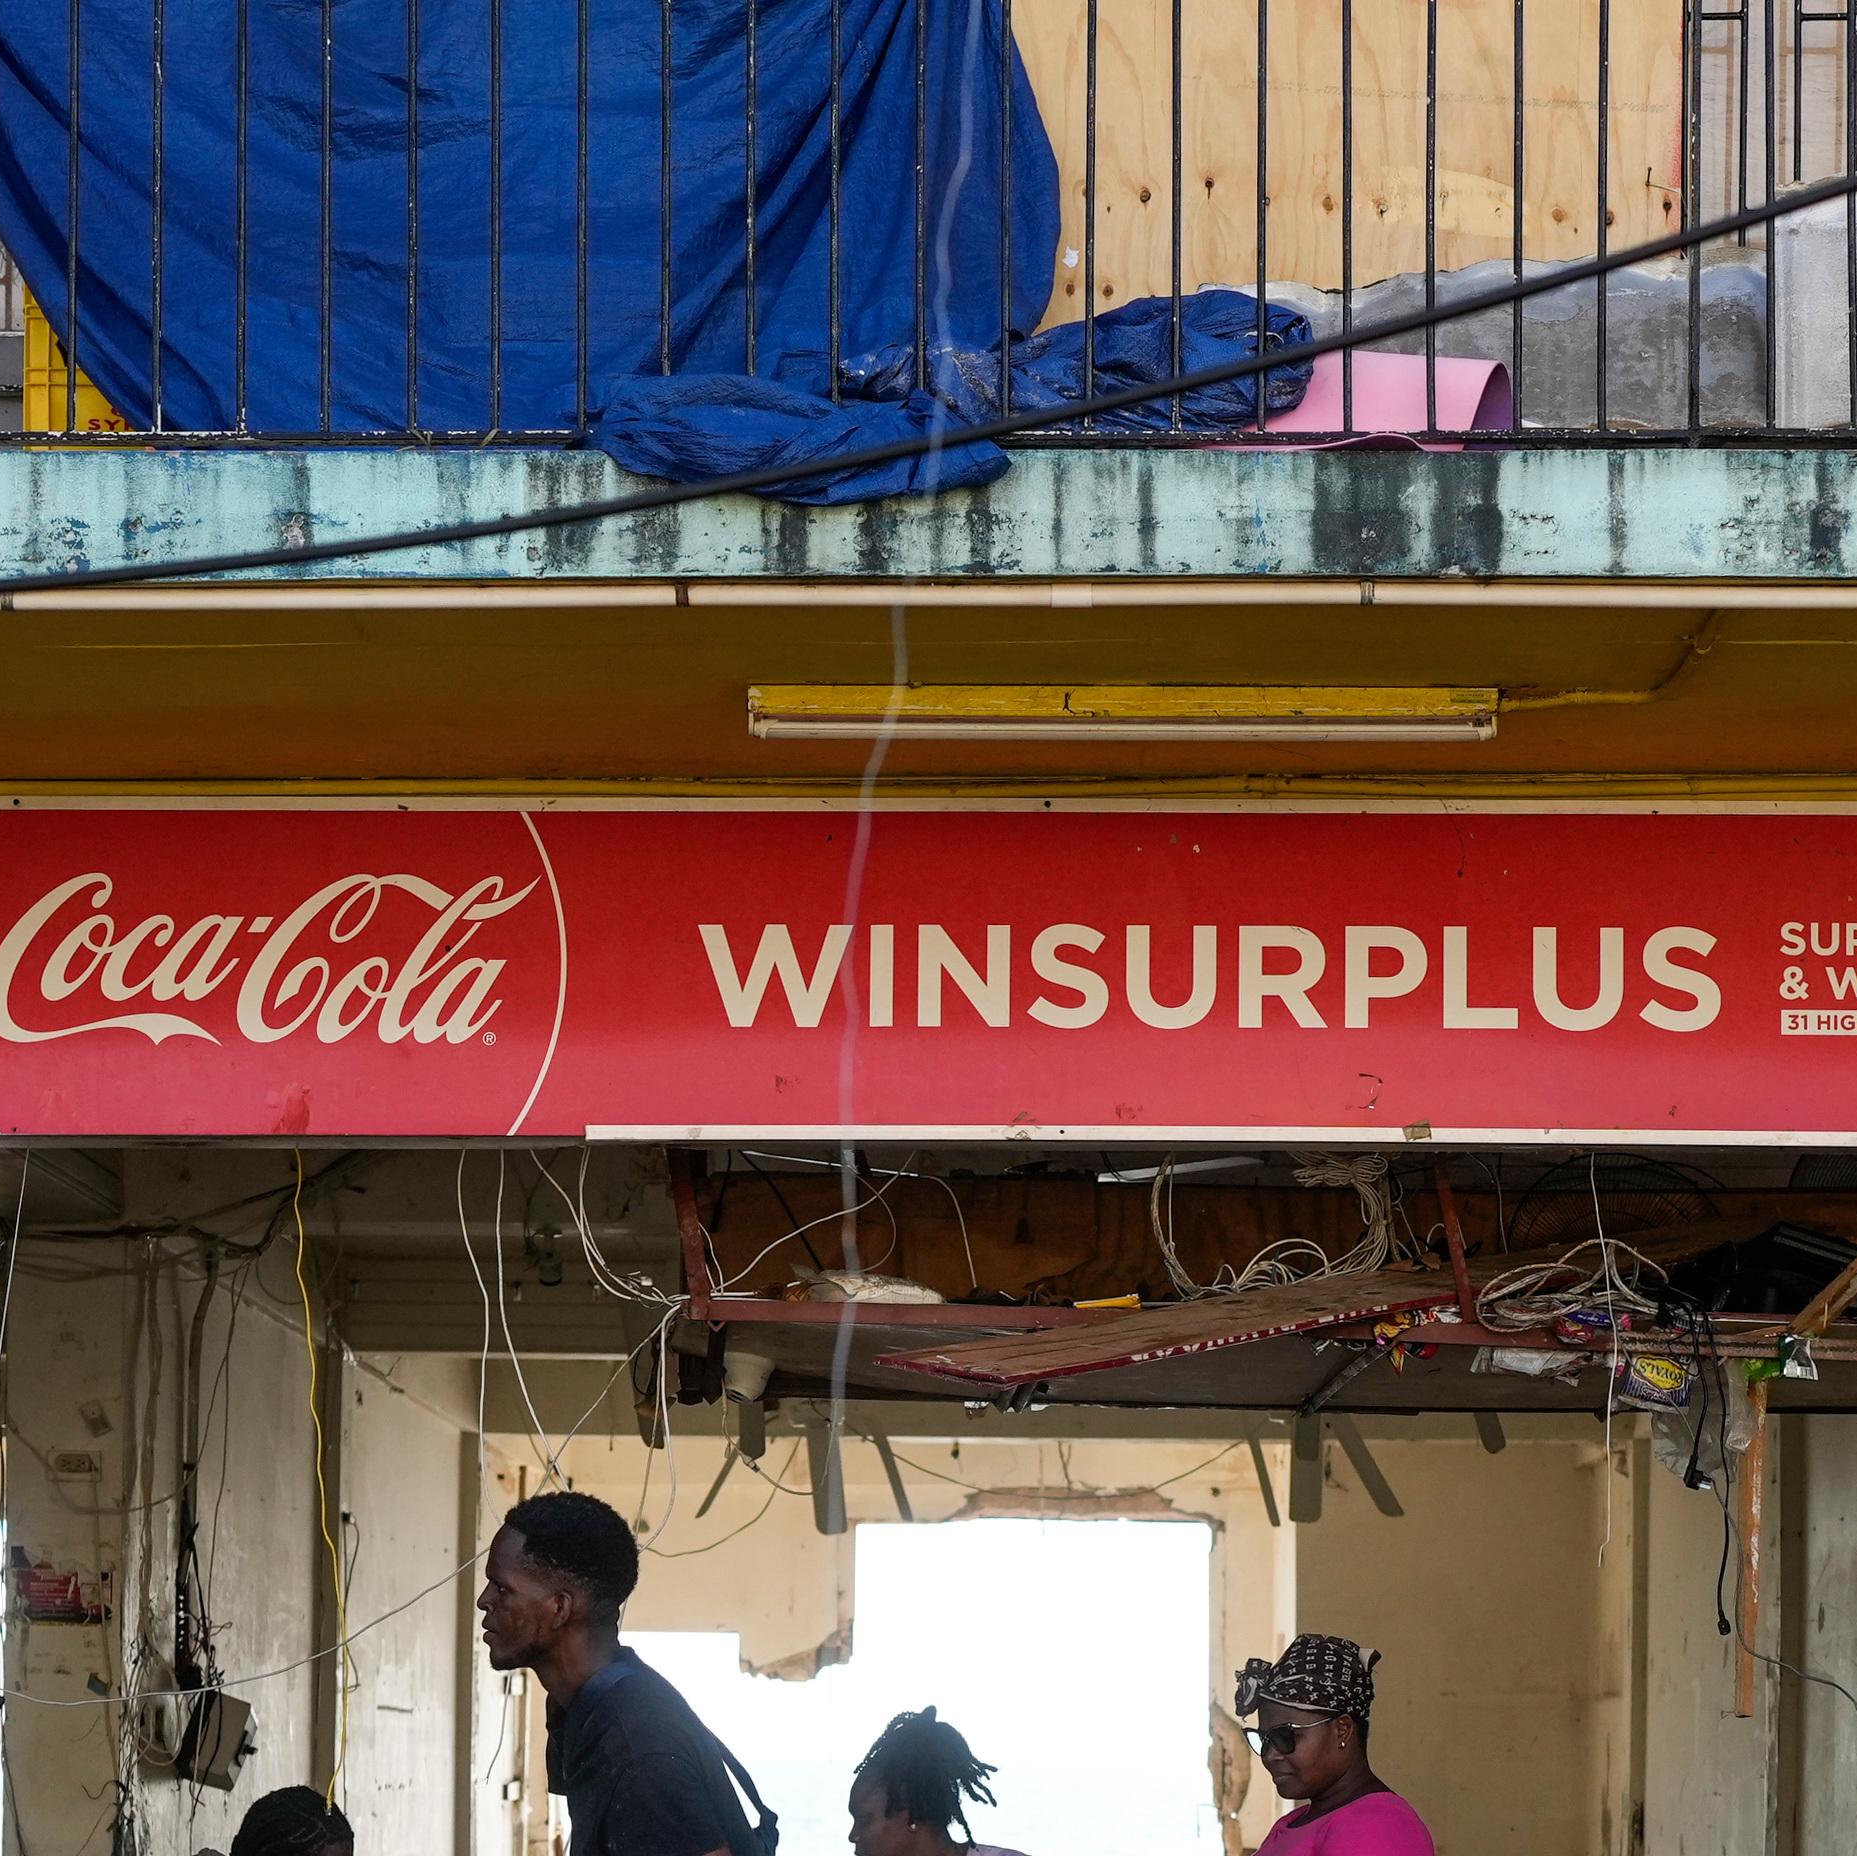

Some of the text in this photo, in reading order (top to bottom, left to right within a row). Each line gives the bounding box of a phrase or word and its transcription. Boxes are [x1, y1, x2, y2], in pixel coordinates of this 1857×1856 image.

[698, 922, 1722, 1033] WINSURPLUS
[1779, 965, 1810, 1000] &
[1787, 1014, 1808, 1031] 31
